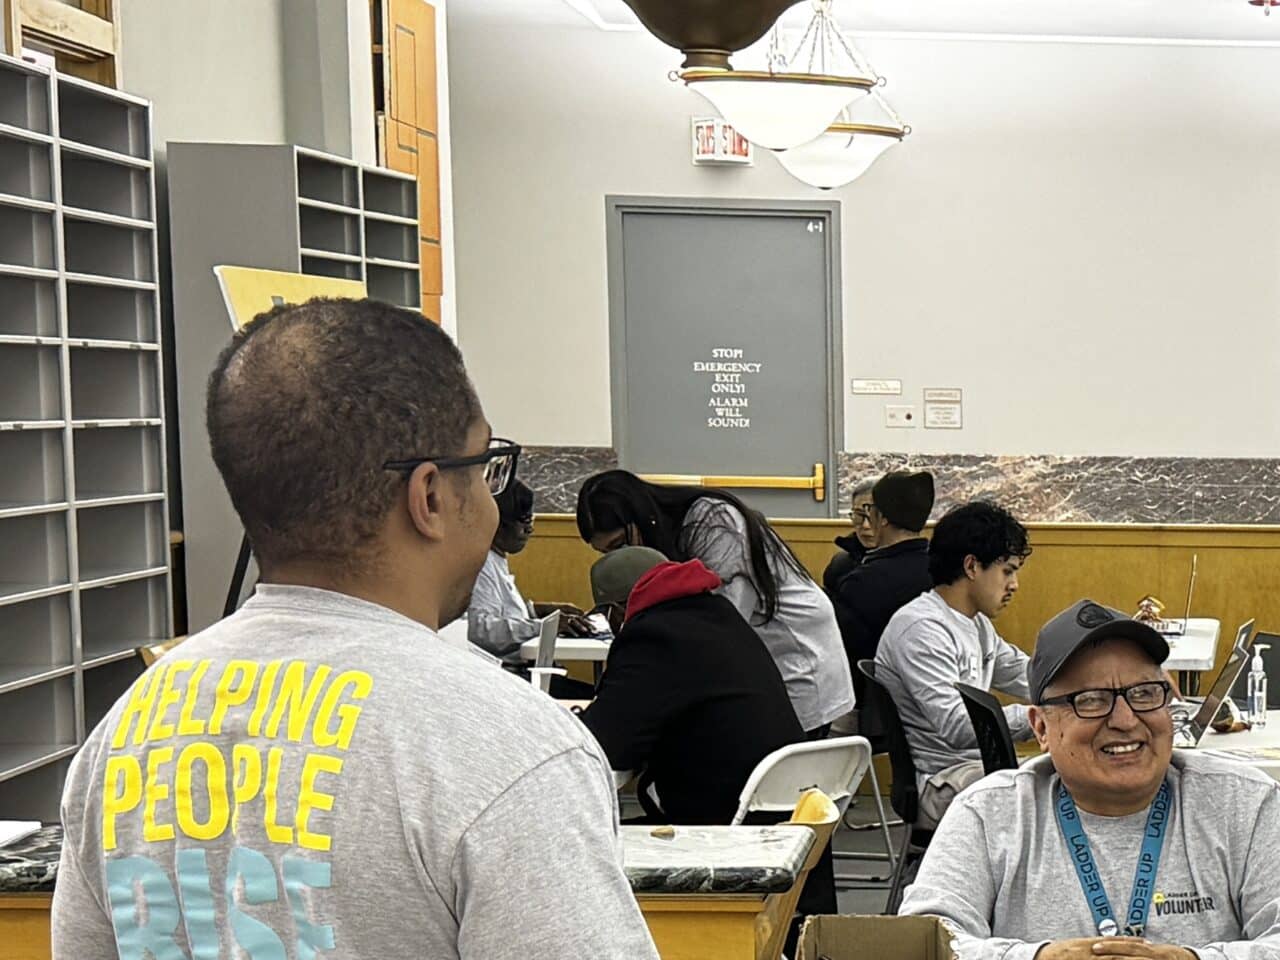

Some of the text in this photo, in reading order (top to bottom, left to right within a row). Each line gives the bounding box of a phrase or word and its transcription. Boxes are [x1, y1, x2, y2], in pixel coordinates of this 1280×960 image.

[693, 361, 762, 373] EMERGENCY
[714, 373, 741, 383] EXIT
[708, 397, 748, 407] ALARM
[714, 407, 743, 417] WILL
[111, 658, 374, 751] HELPING
[102, 741, 344, 852] PEOPLE
[1060, 801, 1076, 820] UP
[1070, 834, 1100, 895] LADDER
[1092, 895, 1109, 918] UP
[1129, 852, 1154, 927] DDER UP
